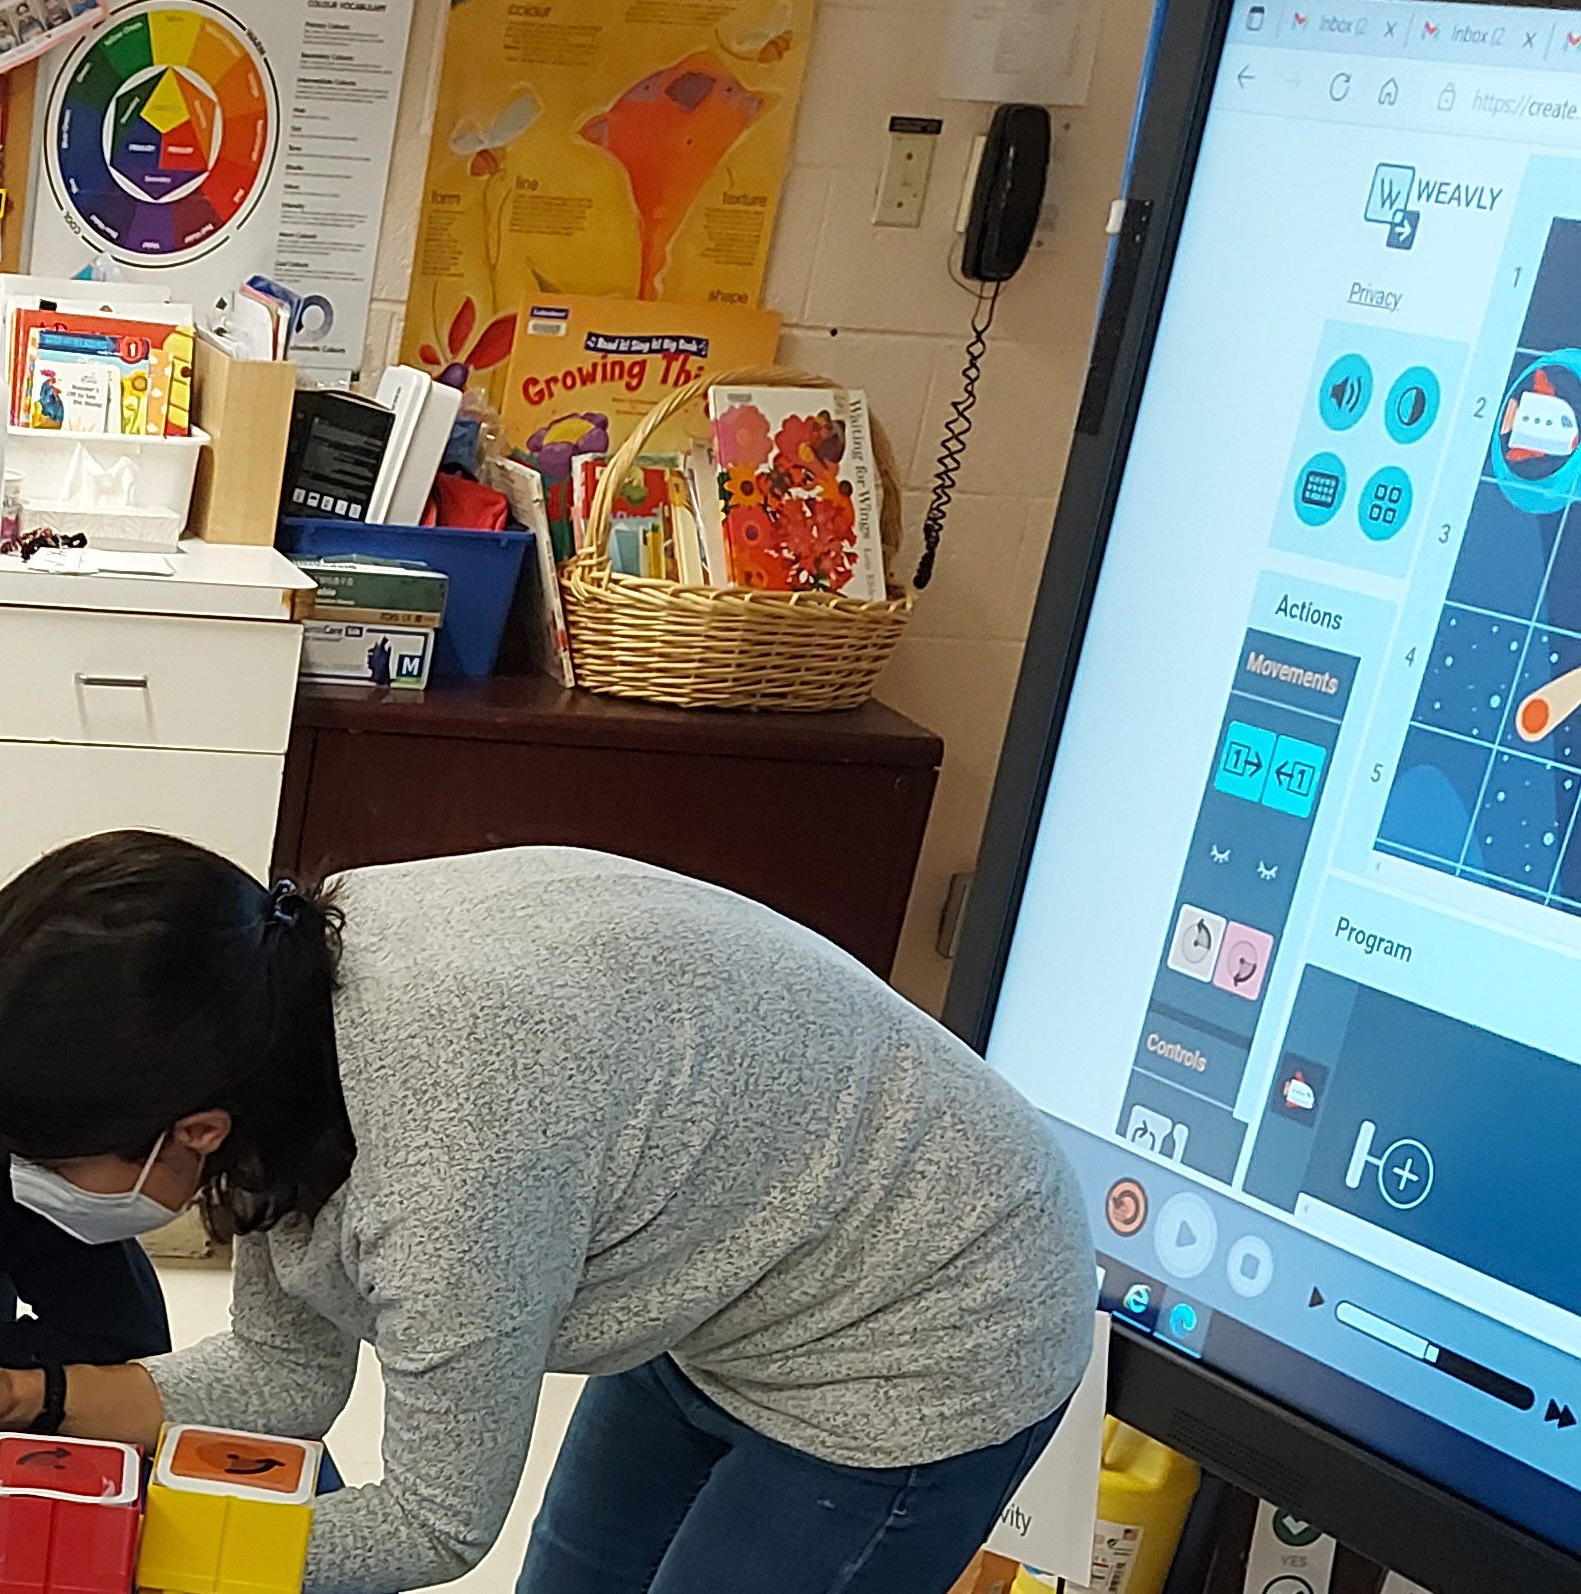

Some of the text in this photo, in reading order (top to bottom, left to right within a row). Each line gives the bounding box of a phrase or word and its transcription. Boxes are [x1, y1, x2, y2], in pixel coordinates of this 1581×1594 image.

[507, 4, 553, 18] colour
[1319, 13, 1353, 33] Inbox
[1450, 22, 1488, 44] Inbox
[515, 175, 539, 191] line
[1417, 177, 1504, 212] WEAVLY
[431, 190, 461, 206] form
[1513, 265, 1522, 289] 1
[1347, 280, 1403, 313] Privacy
[129, 342, 137, 358] 1
[522, 353, 648, 406] Growing
[1473, 396, 1487, 419] 2
[849, 399, 866, 463] Waiting
[854, 465, 869, 489] for
[858, 490, 872, 540] Wings
[1438, 523, 1451, 544] 3
[1274, 593, 1343, 630] Actions
[401, 656, 421, 676] M
[1405, 646, 1417, 667] 4
[1246, 651, 1339, 695] Movements
[1370, 763, 1384, 783] 5
[1334, 915, 1413, 963] Program
[1146, 1033, 1208, 1073] Controls
[1281, 1555, 1308, 1568] YES
